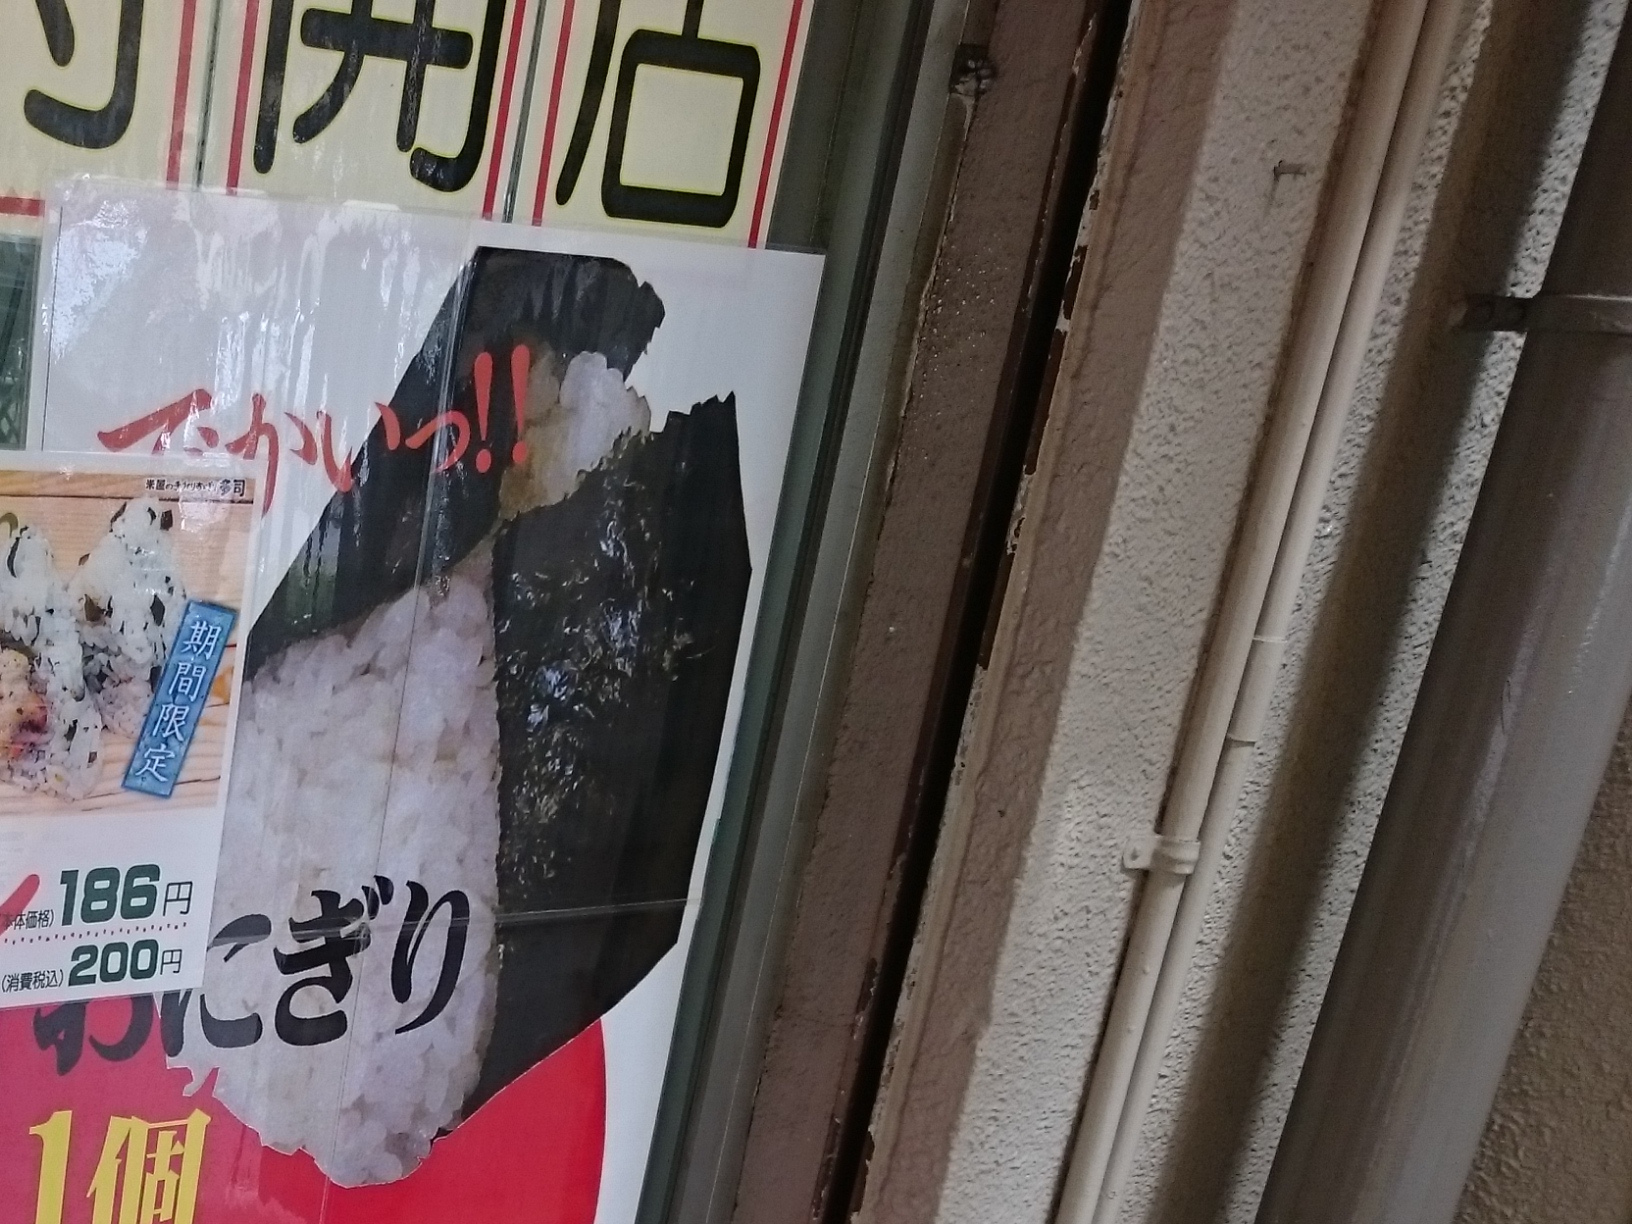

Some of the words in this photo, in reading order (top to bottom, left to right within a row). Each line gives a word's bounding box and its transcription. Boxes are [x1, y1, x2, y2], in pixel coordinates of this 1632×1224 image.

[135, 615, 222, 783] 期間限定
[60, 864, 193, 927] 186円
[1, 970, 64, 993] (消費税込)
[68, 939, 183, 987] 200円
